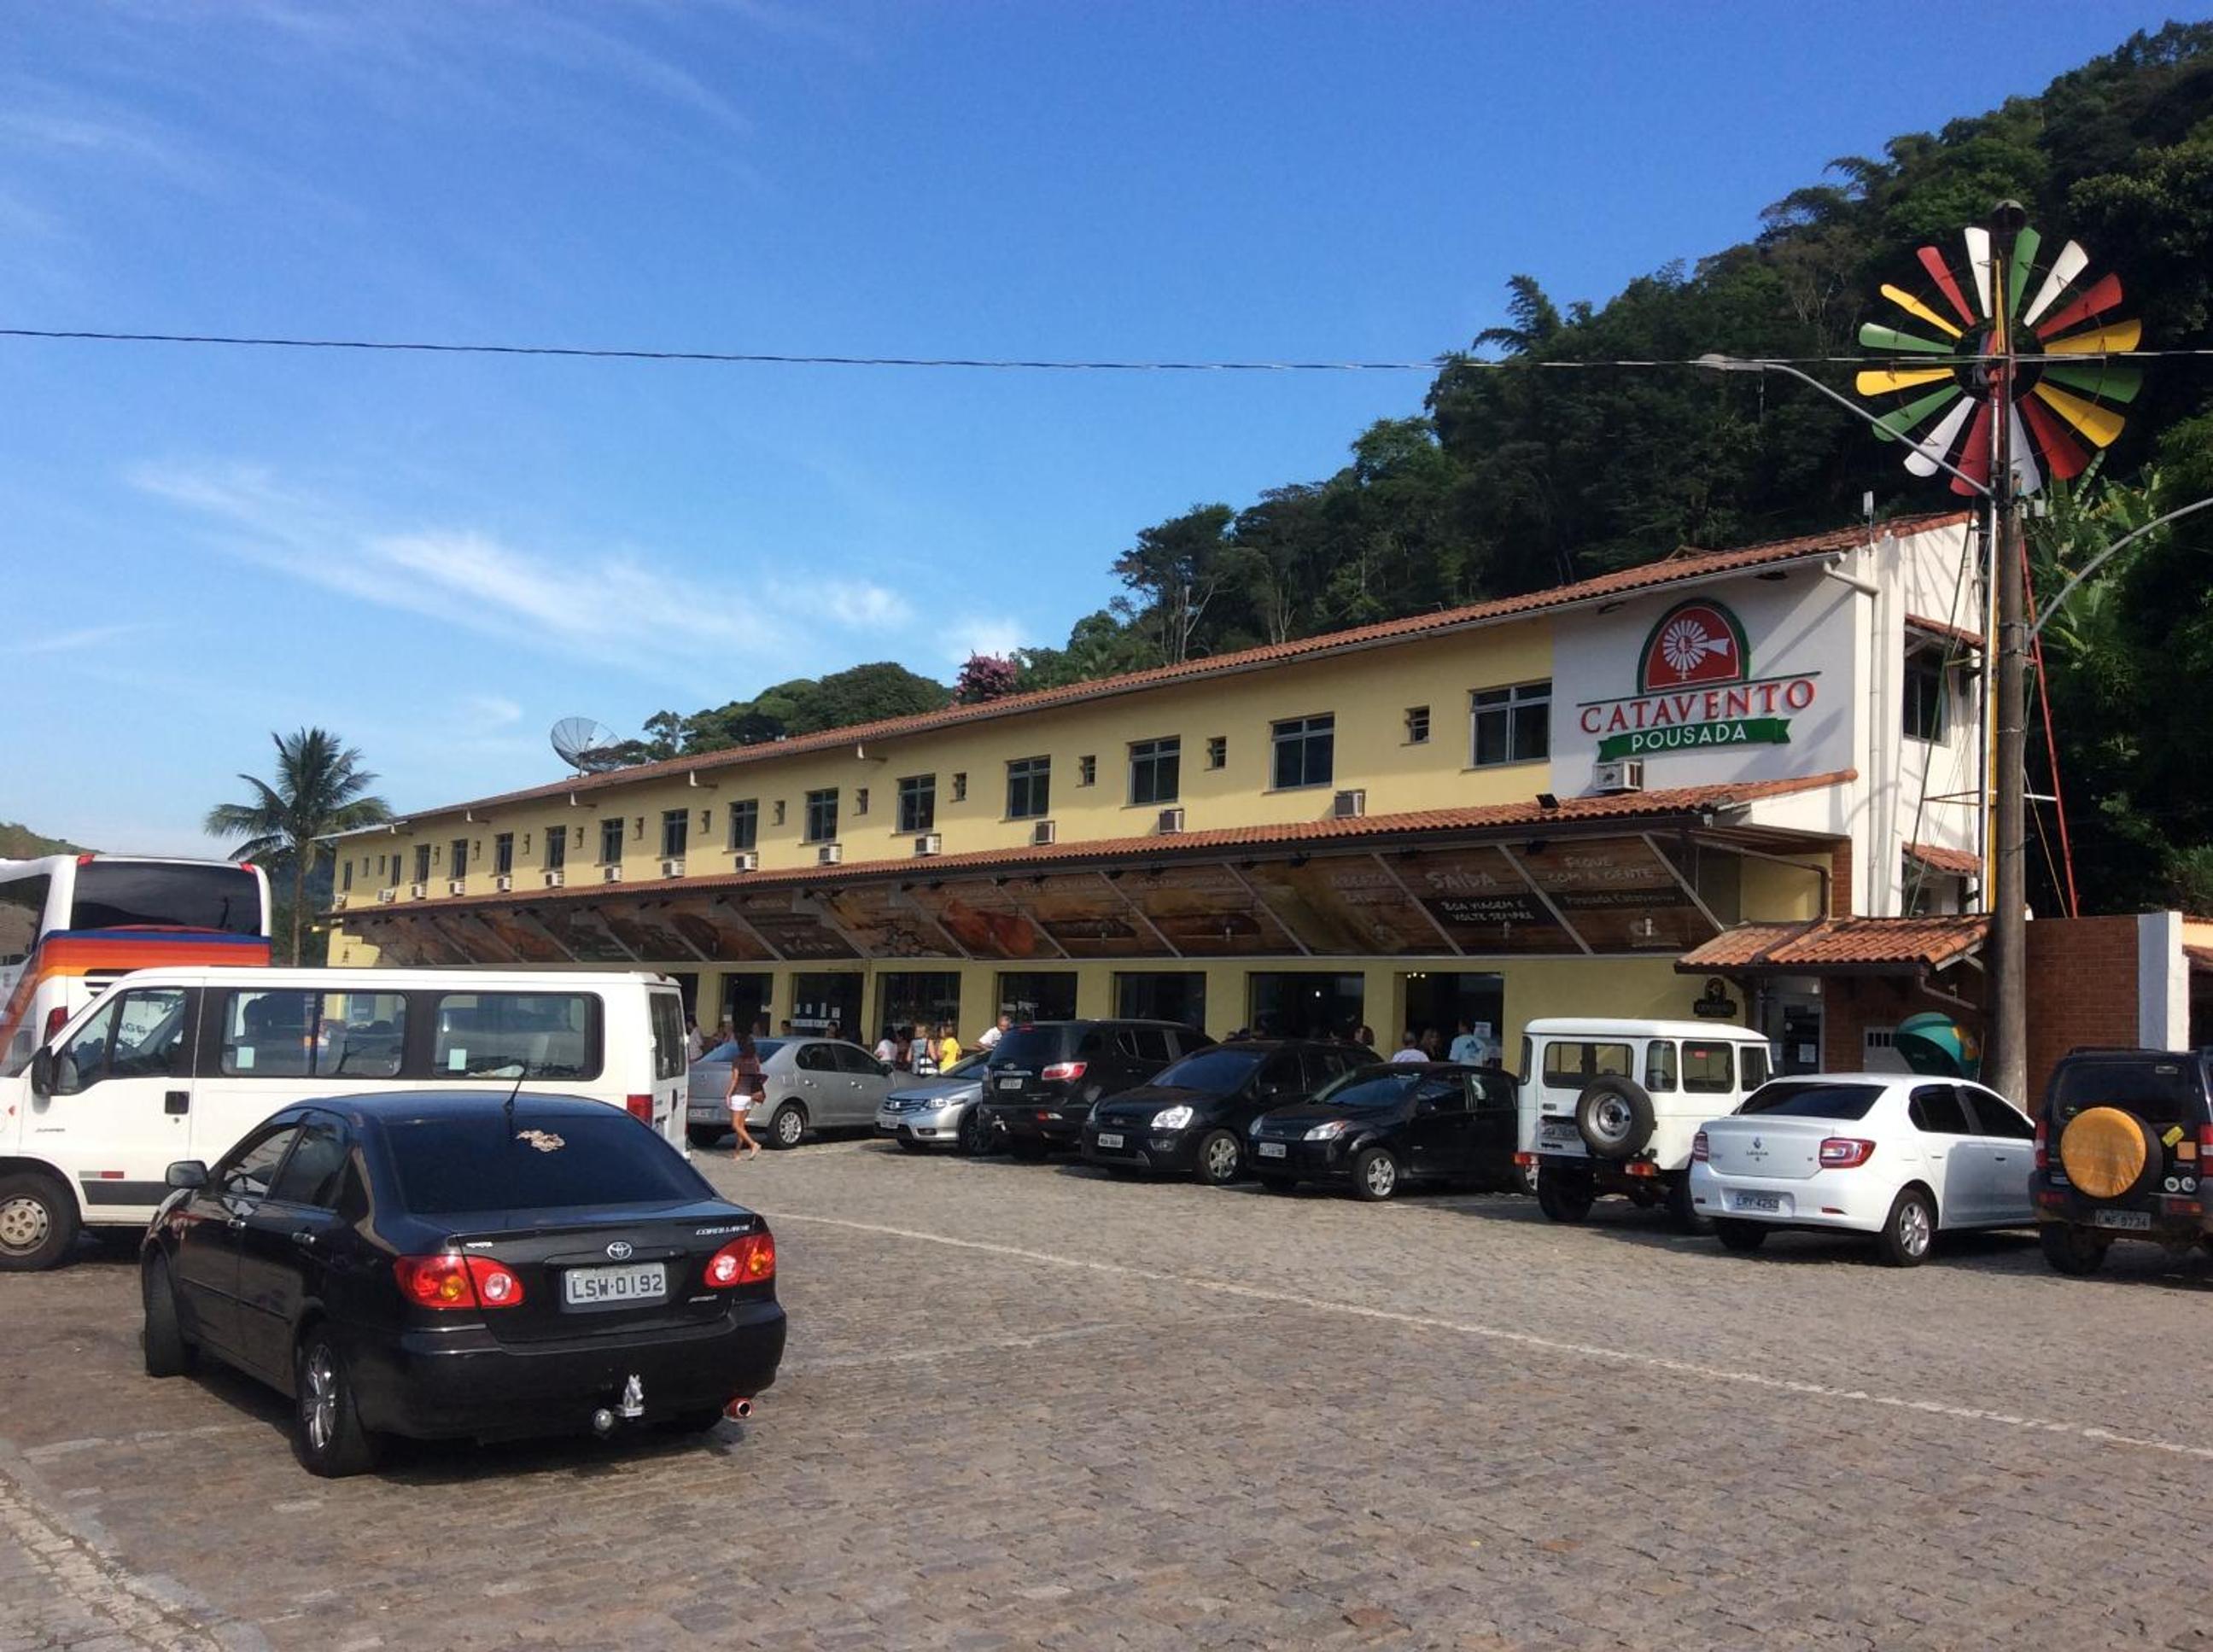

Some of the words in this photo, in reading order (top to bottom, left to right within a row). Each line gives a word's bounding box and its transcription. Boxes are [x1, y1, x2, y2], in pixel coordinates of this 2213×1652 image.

[1581, 679, 1815, 733] CATAVENTO
[1632, 723, 1747, 752] POUSADA
[1425, 865, 1498, 889] SAÍDA
